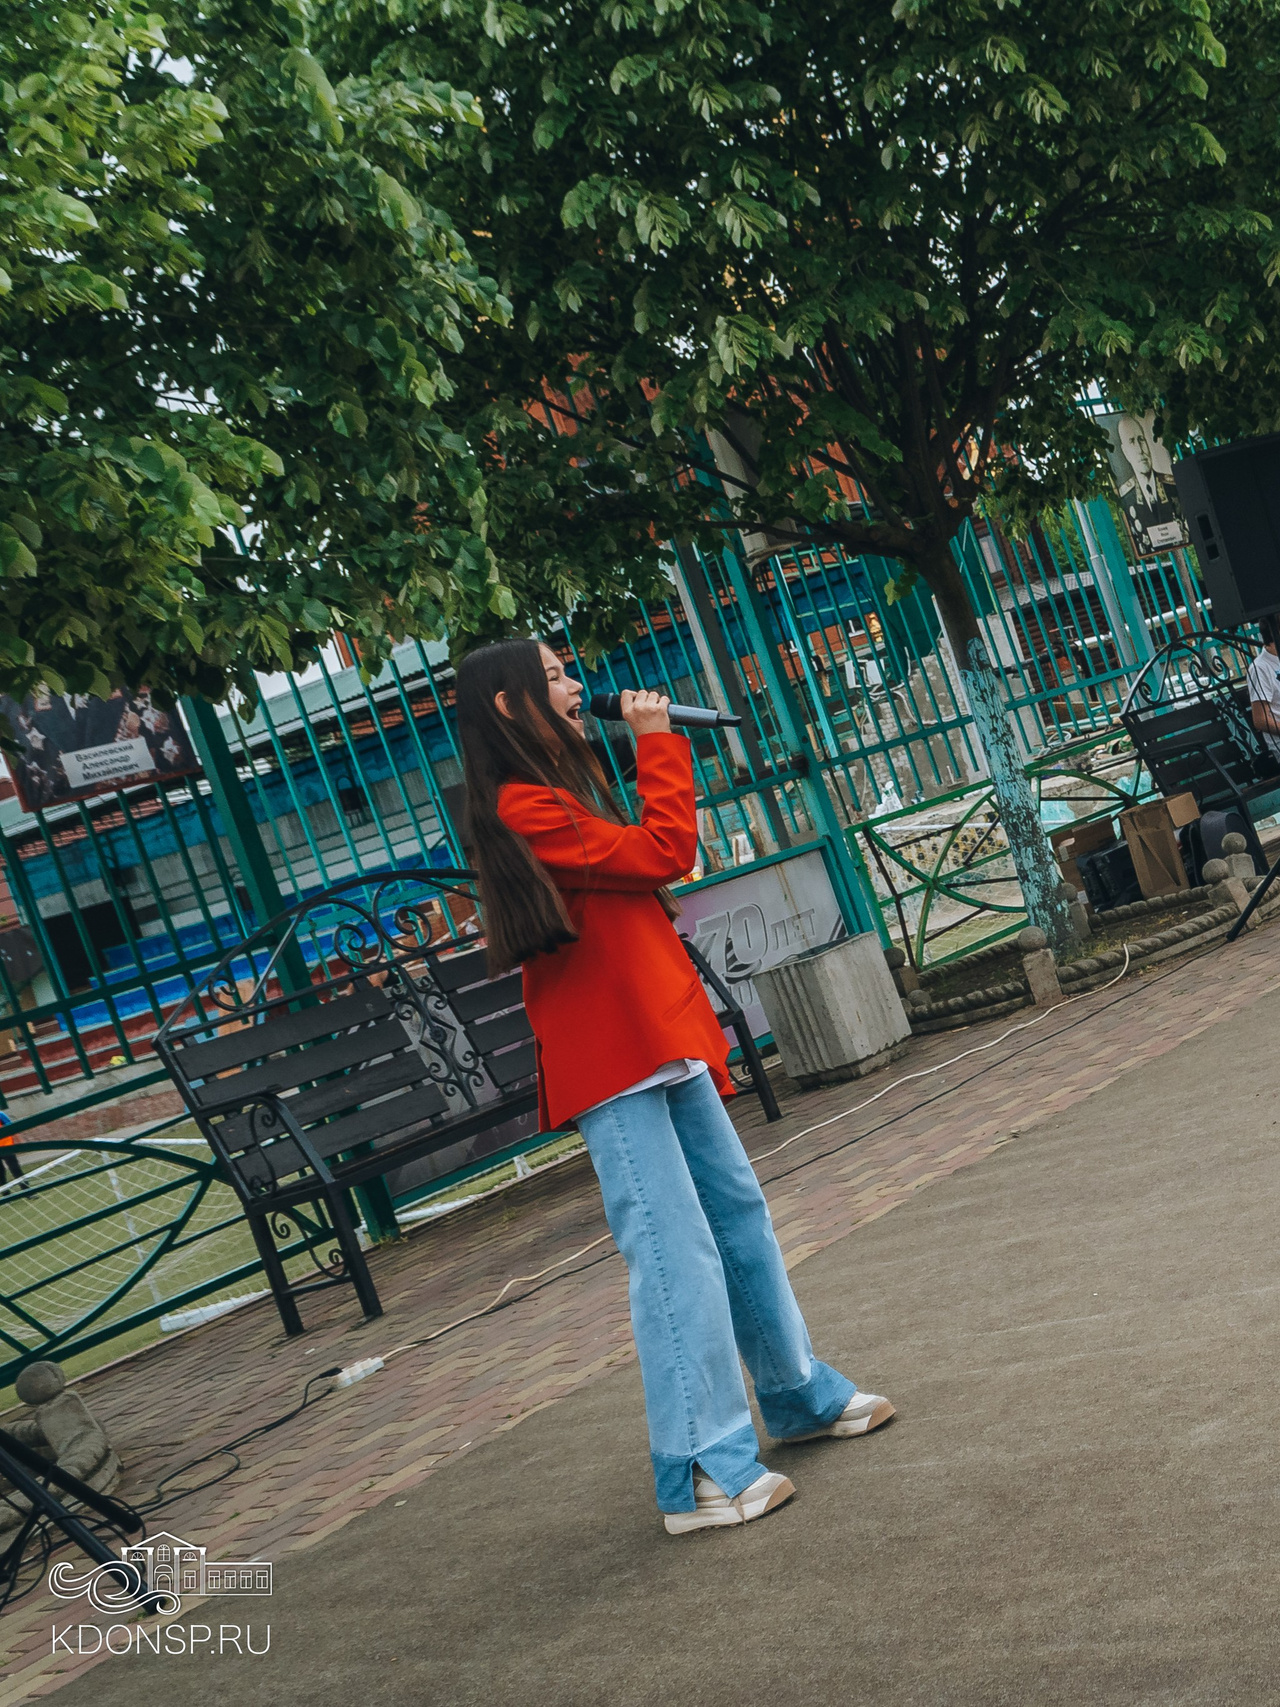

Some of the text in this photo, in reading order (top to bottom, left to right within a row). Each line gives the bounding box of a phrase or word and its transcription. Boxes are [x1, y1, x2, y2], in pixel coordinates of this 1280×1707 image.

[82, 755, 131, 771] Александр
[82, 763, 139, 780] Михайлович
[696, 903, 816, 974] 70 ЛЕТ
